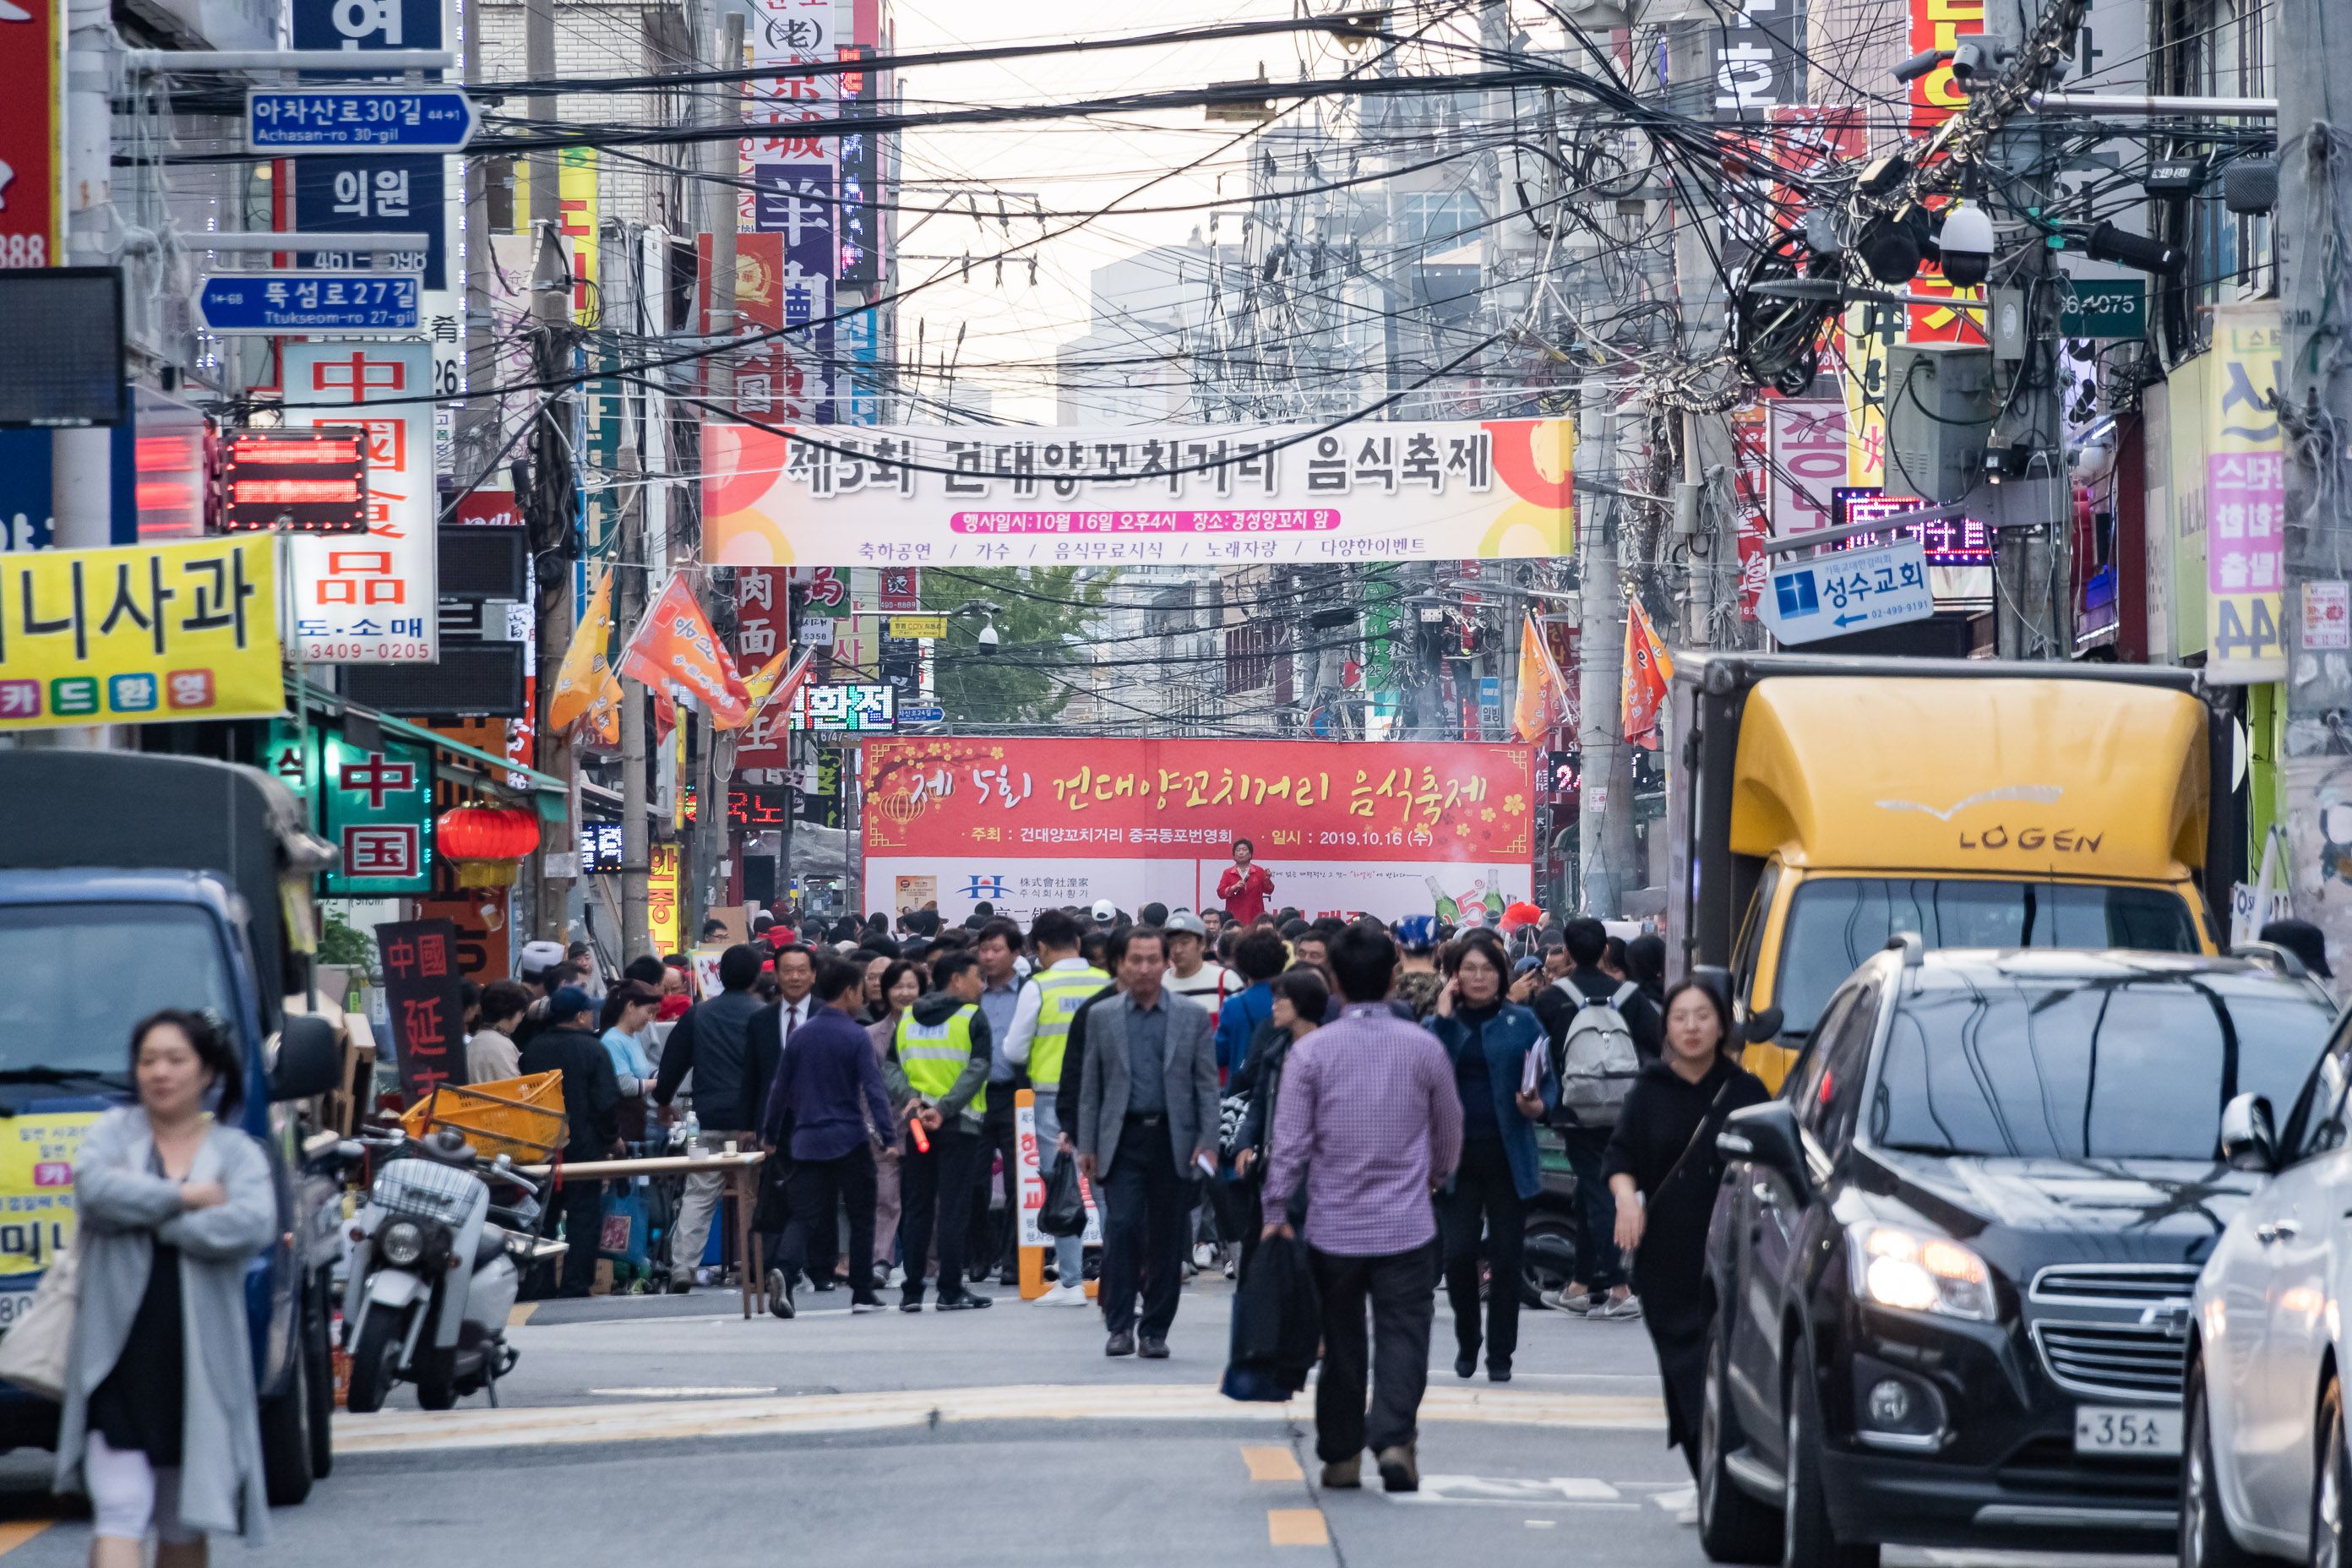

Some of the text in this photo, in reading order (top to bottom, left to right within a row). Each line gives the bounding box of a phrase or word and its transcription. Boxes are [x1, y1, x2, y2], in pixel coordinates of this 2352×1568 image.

[255, 98, 422, 126] 아차산로30길
[258, 128, 399, 144] Achasan-ro 30-gil
[334, 170, 410, 217] 의원
[264, 281, 415, 309] 뚝섬로27길
[264, 311, 416, 326] Ttukseom-ro 27-gil
[790, 433, 1488, 495] 제5회 건대양꼬치거리 음식축제
[963, 510, 1329, 532] 행사일시:10월 16일 오후4시 장소:경성양꼬치 앞
[858, 542, 931, 560] 축하공연
[976, 543, 1010, 560] 가수
[1054, 541, 1163, 560] 음식무료시식
[1206, 539, 1278, 558] 노래자랑
[1320, 537, 1427, 557] 다양한이벤트
[0, 547, 254, 662] 니사과
[1823, 562, 1924, 609] 성수교회
[1872, 601, 1928, 619] 02-499-9191
[738, 568, 778, 752] 肉面王
[2, 674, 207, 712] 카드환영
[911, 770, 953, 803] 제
[973, 765, 1032, 808] 5회
[1054, 765, 1329, 810] 건대양꼬치거리
[1349, 765, 1487, 825] 음식축제
[340, 752, 420, 878] 中国
[972, 827, 1001, 842] 주최
[1020, 827, 1123, 843] 건대양꼬치거리
[1129, 827, 1233, 845] 중국동포번영회
[1271, 830, 1301, 846] 일시
[1320, 831, 1402, 846] 2019.10.16
[1407, 830, 1434, 847] (수)
[1959, 825, 2104, 854] LOGEN
[389, 934, 447, 979] 中國
[2095, 1408, 2160, 1448] 35소
